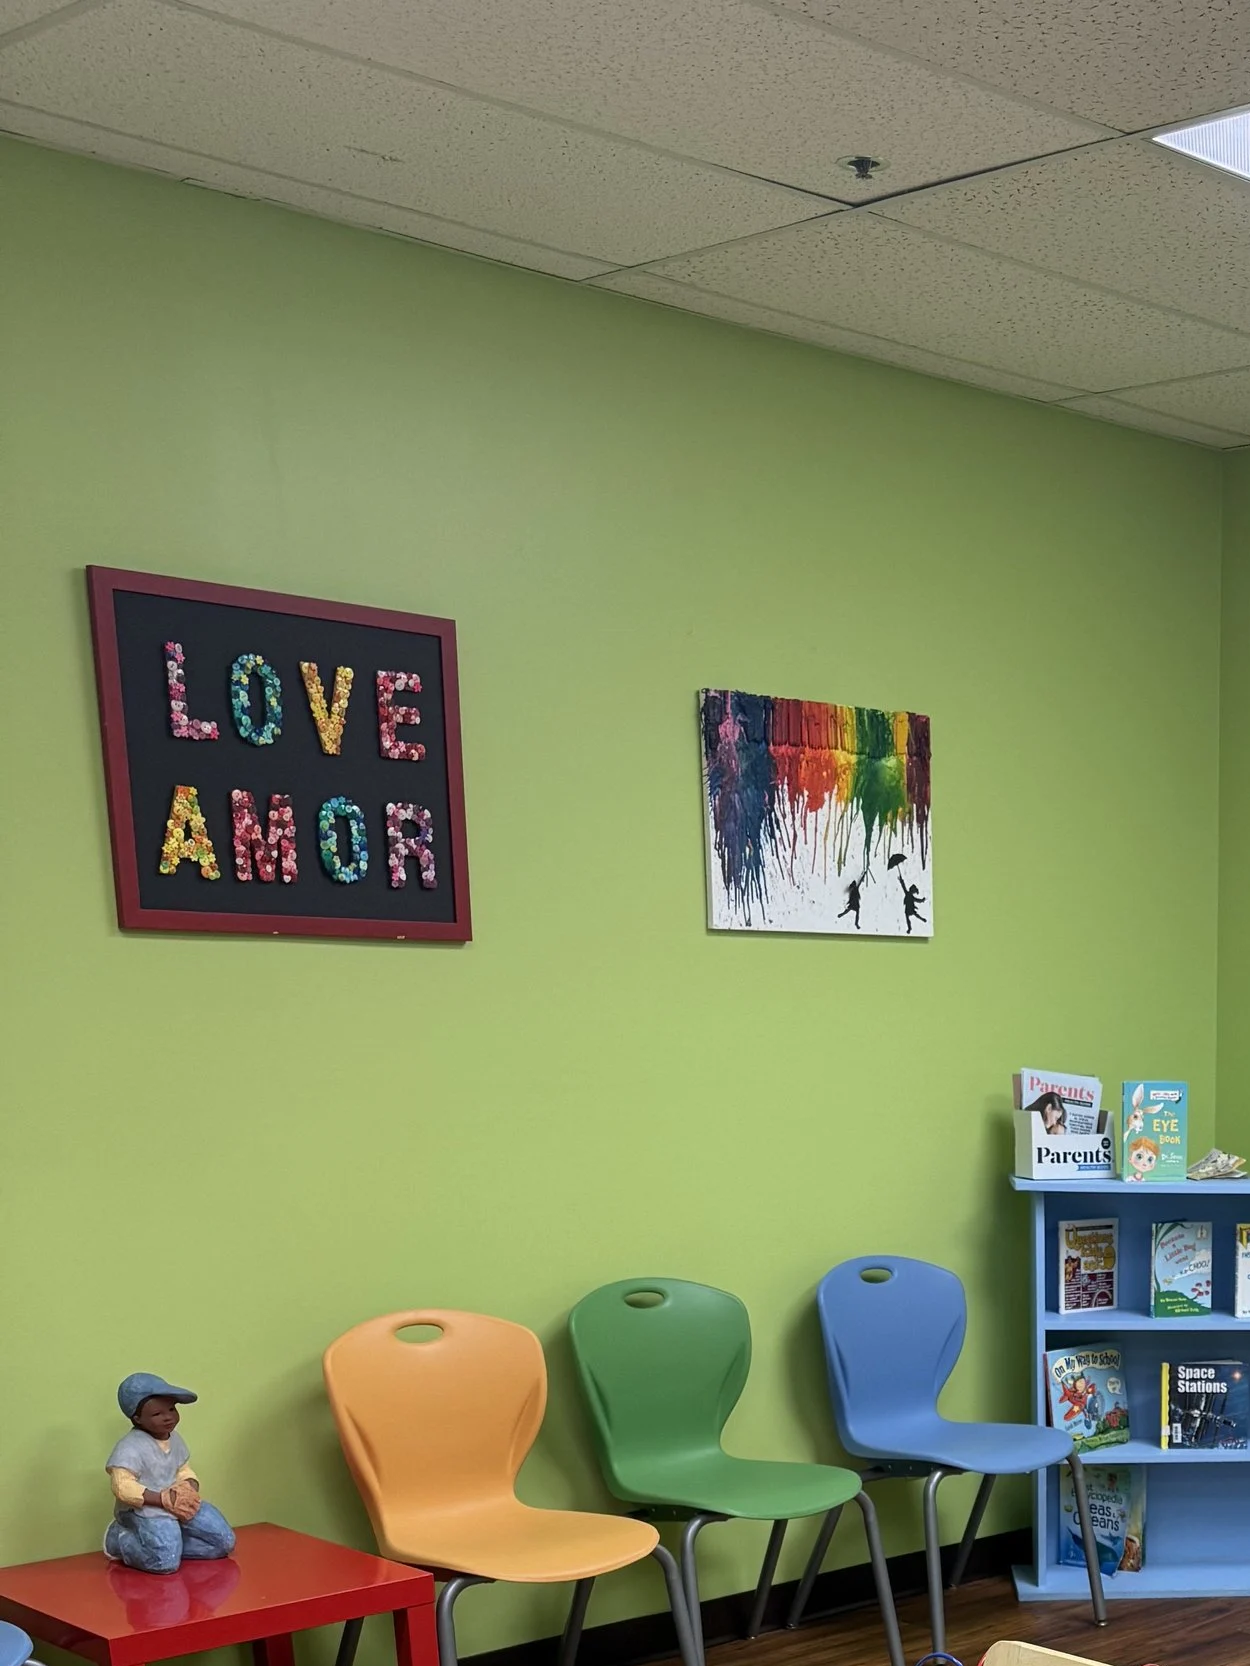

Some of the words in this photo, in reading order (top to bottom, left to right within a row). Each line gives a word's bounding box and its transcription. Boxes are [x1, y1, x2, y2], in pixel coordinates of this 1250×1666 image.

[163, 641, 426, 761] LOVE
[158, 785, 438, 889] AMOR
[1029, 1075, 1094, 1101] Parents
[1153, 1118, 1179, 1132] EYE
[1036, 1146, 1112, 1164] Parents
[1054, 1365, 1066, 1378] On
[1091, 1353, 1098, 1365] to
[1177, 1365, 1216, 1380] Space
[1177, 1380, 1228, 1393] Stations
